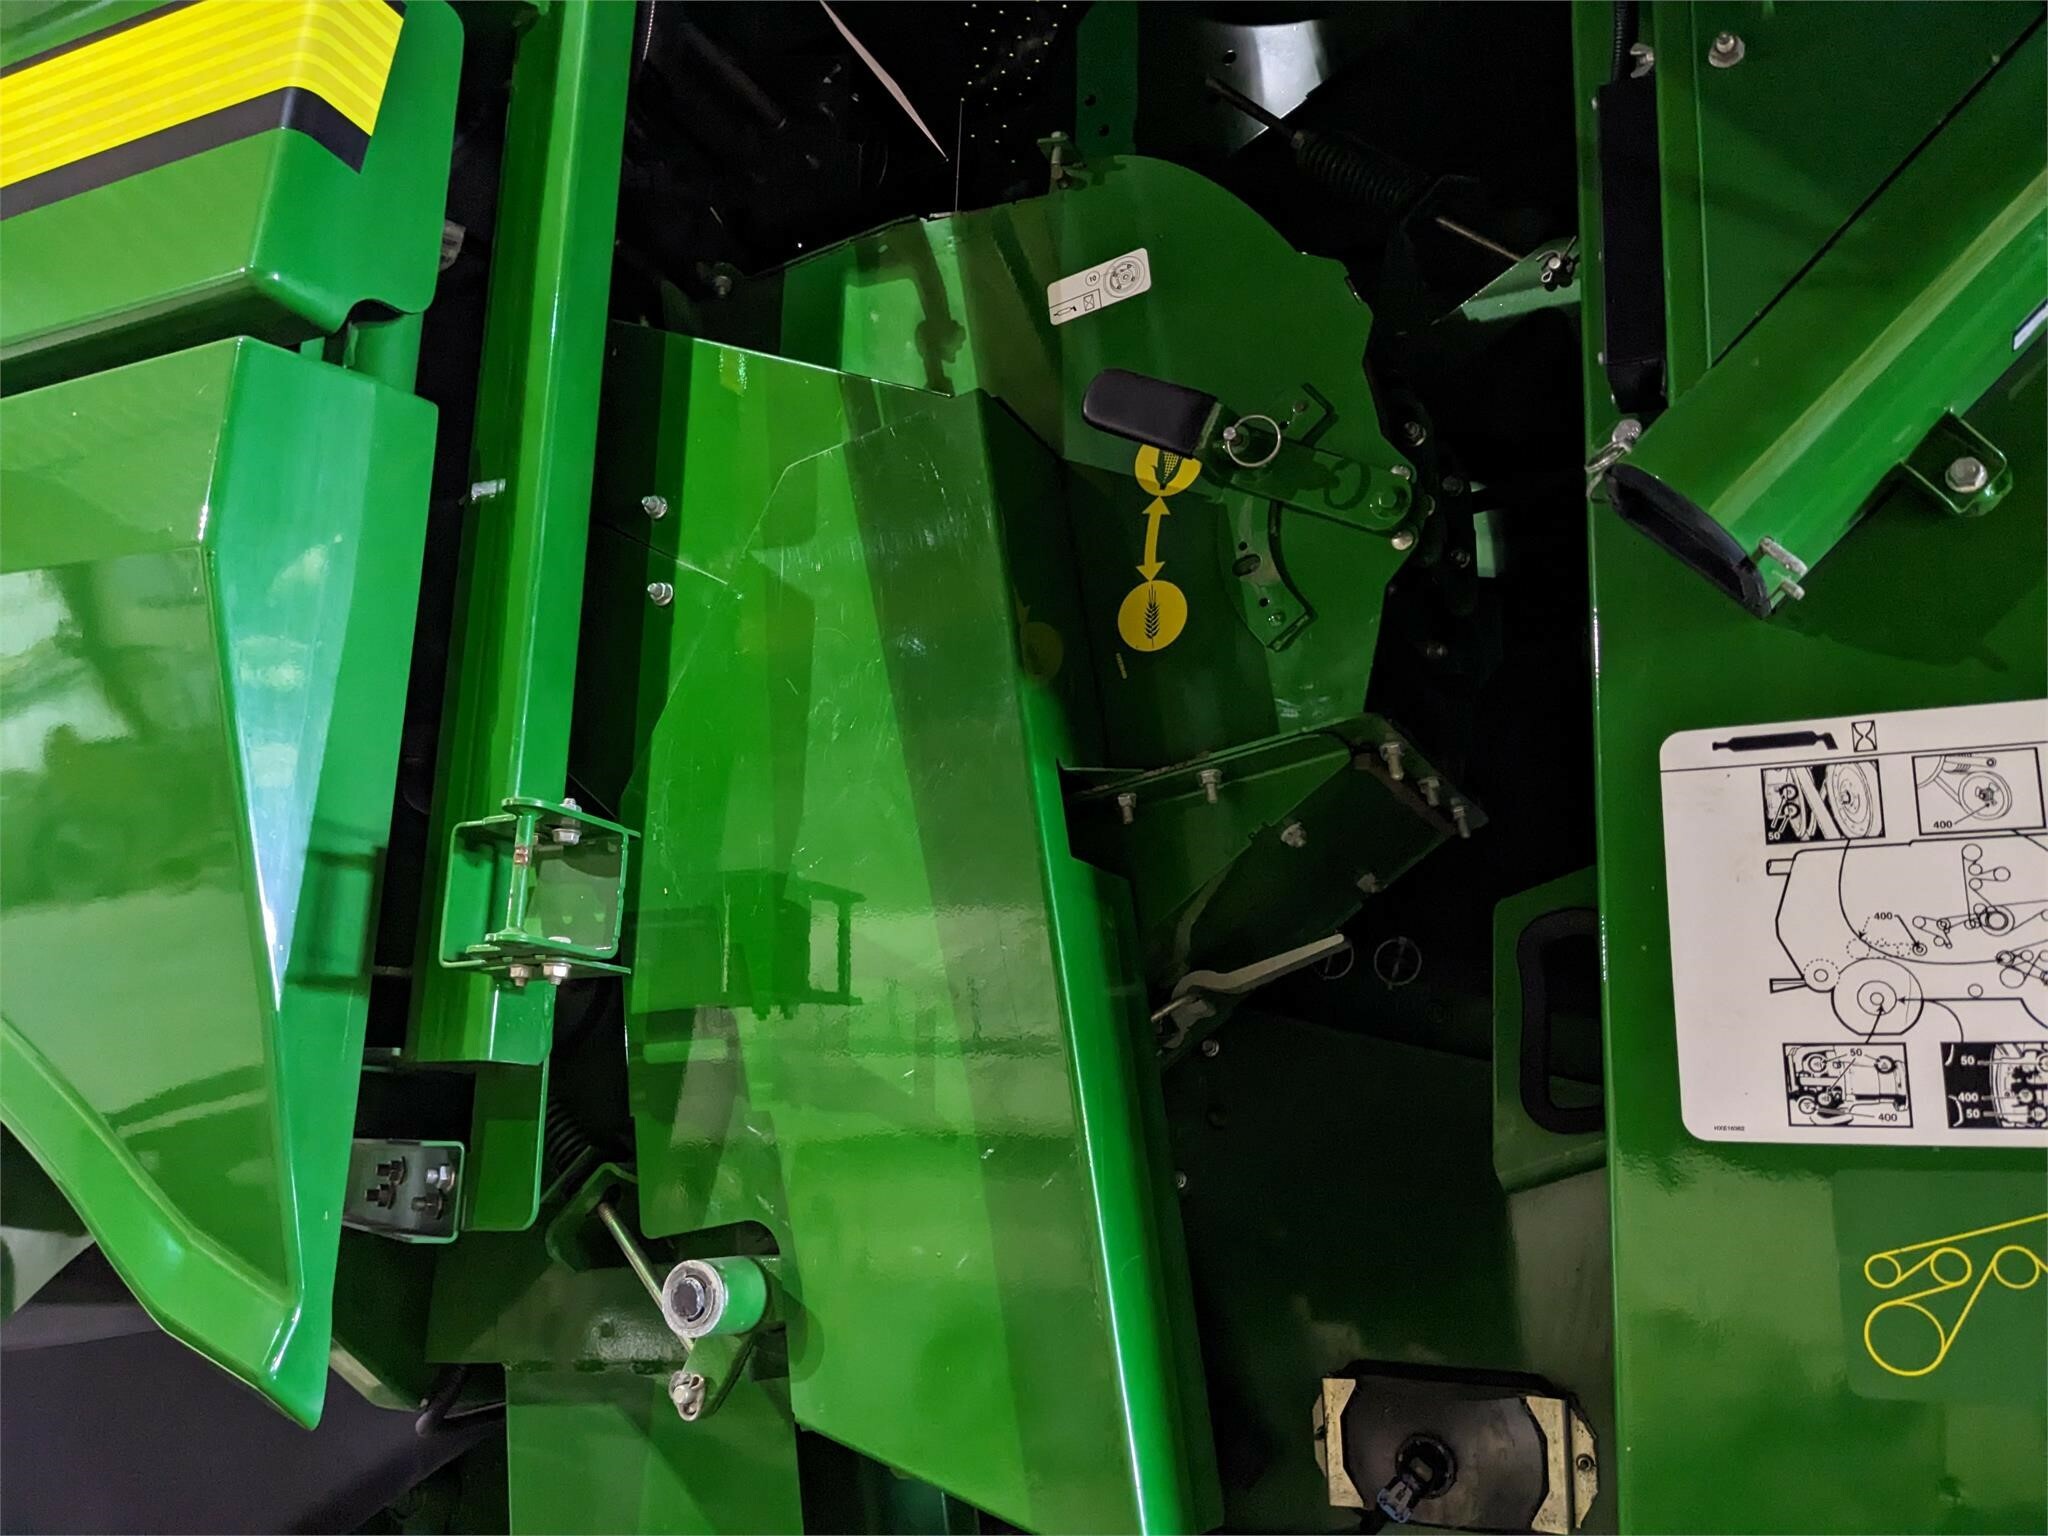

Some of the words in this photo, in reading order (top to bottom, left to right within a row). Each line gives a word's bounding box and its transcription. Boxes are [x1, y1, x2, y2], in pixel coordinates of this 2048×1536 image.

[1933, 821, 1953, 829] 400
[1874, 912, 1893, 920] 400
[1850, 1048, 1862, 1057] 50
[1960, 1056, 1975, 1065] 50
[1958, 1093, 1978, 1101] 400
[1878, 1113, 1897, 1122] 400
[1966, 1109, 1980, 1118] 50
